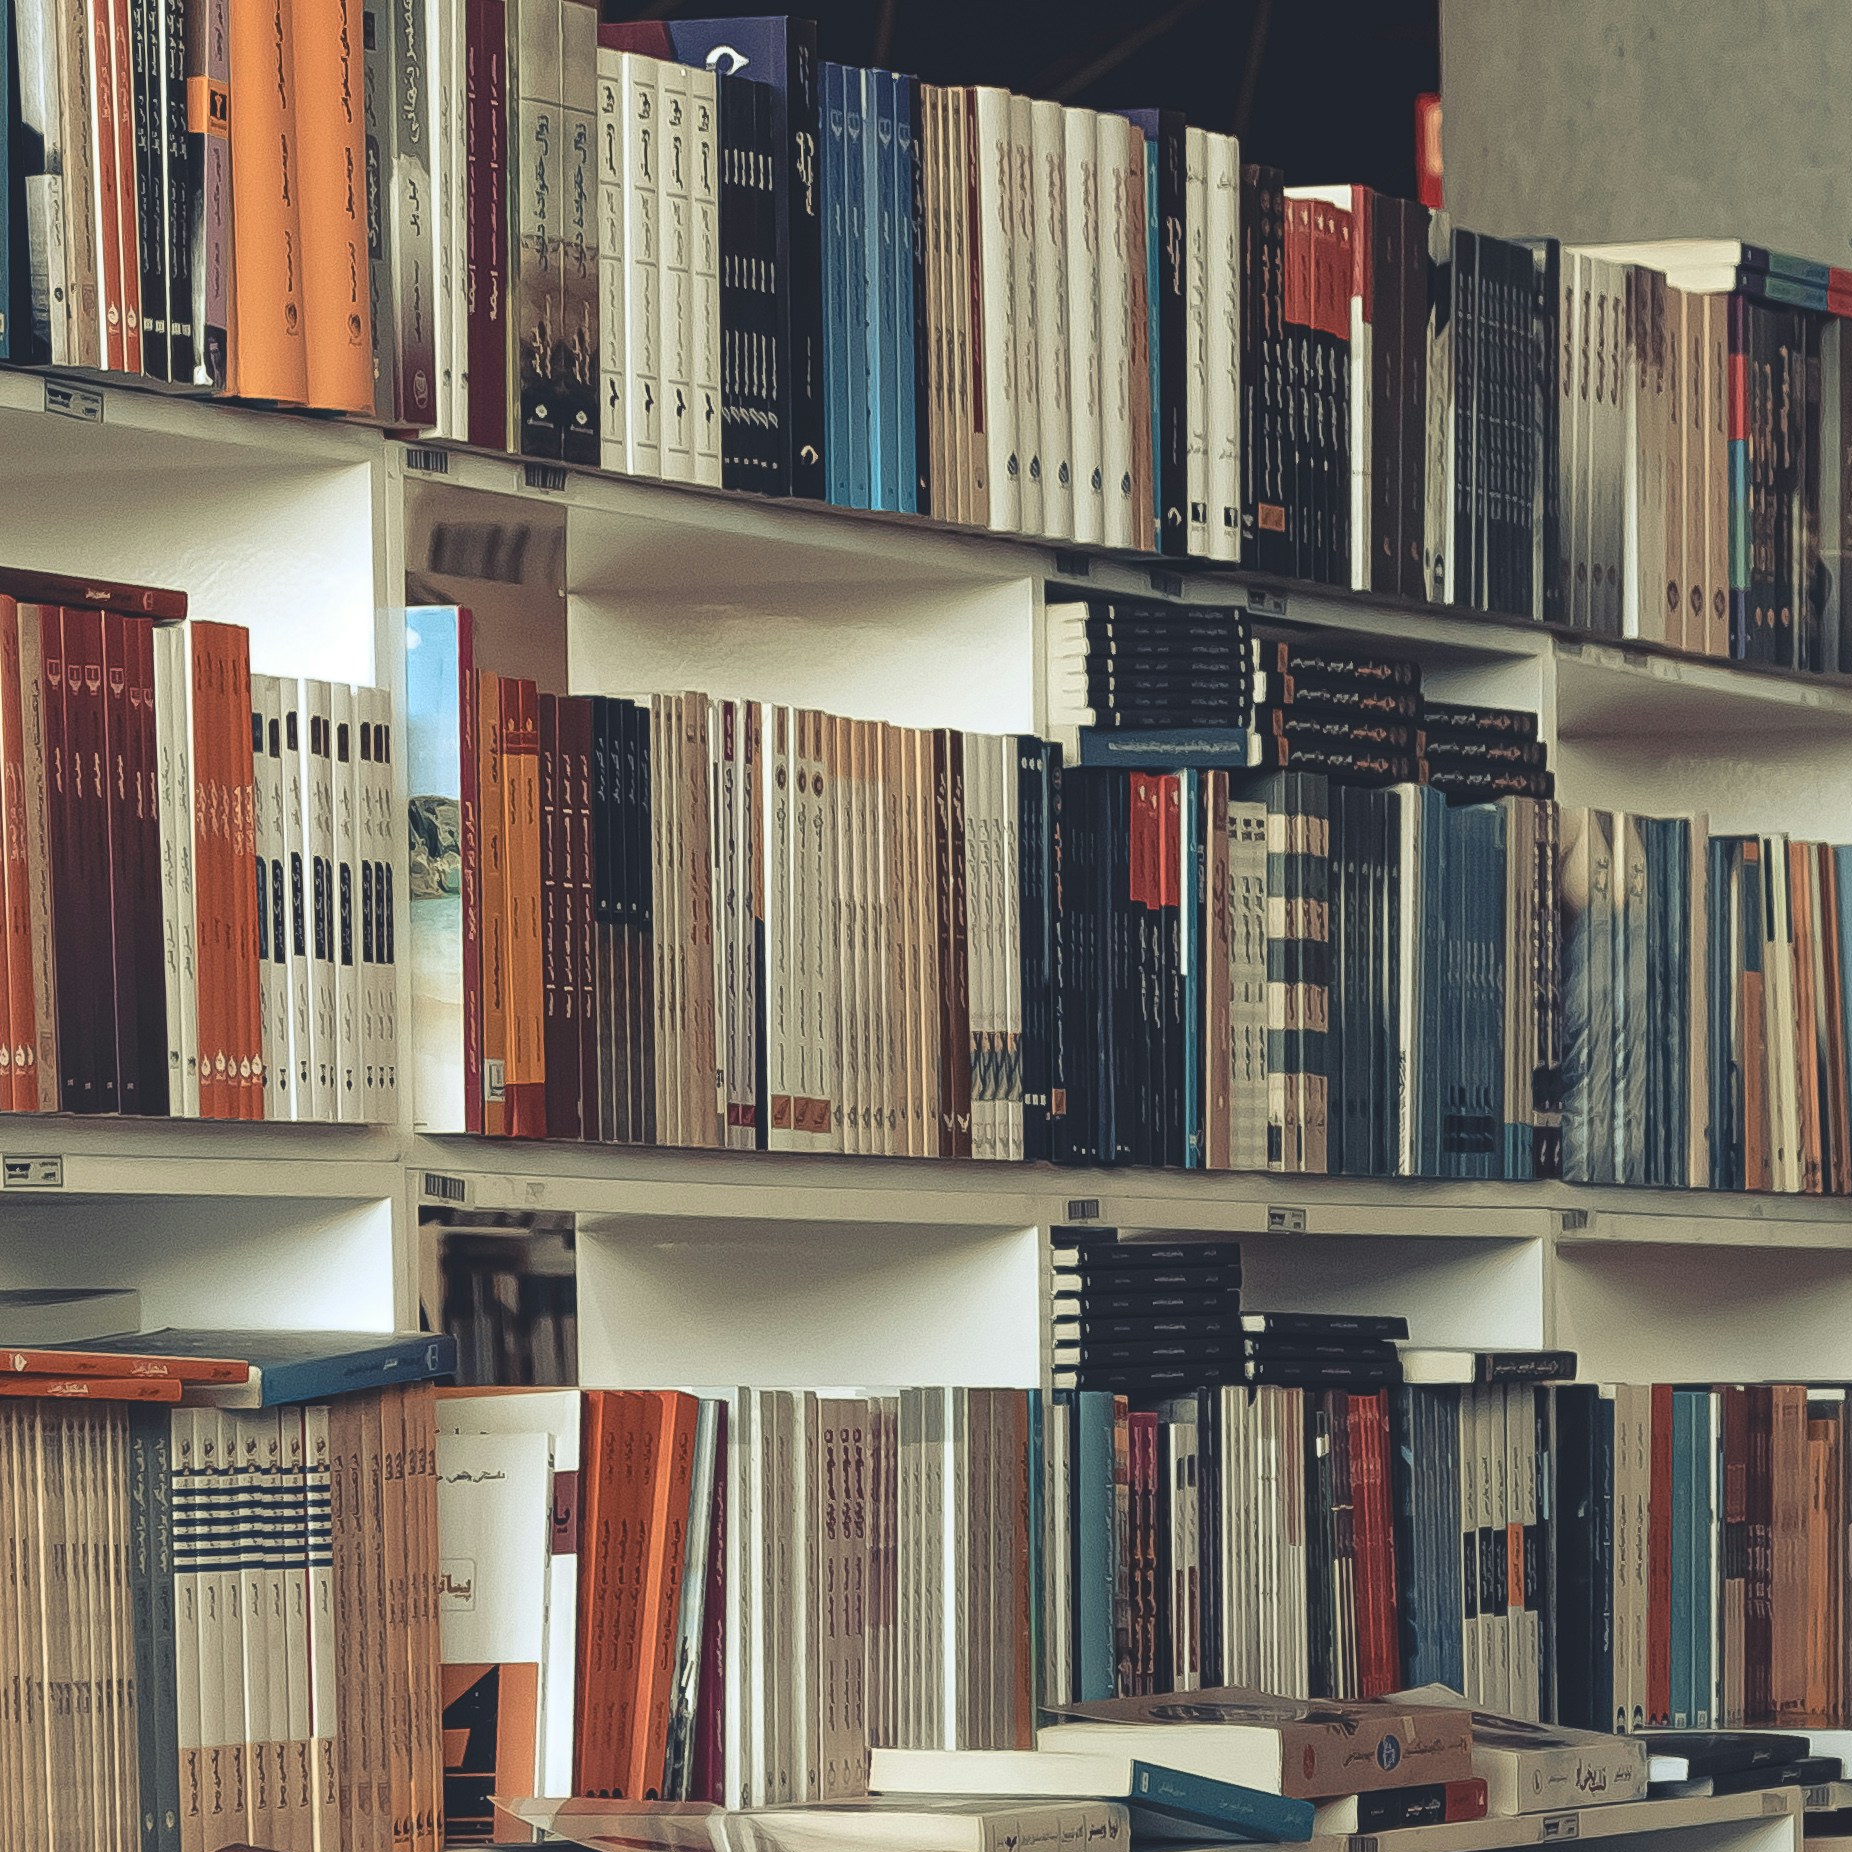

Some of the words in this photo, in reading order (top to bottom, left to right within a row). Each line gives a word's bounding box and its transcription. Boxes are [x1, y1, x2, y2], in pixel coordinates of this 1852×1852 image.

[403, 65, 421, 143] پنهانی
[602, 86, 614, 113] نورا
[638, 93, 650, 118] نورا
[669, 99, 681, 126] نورا
[698, 105, 710, 132] نورا
[605, 123, 616, 177] وبستر
[641, 129, 651, 183] وبستر
[672, 137, 683, 190] وبستر
[701, 142, 710, 196] وبستر
